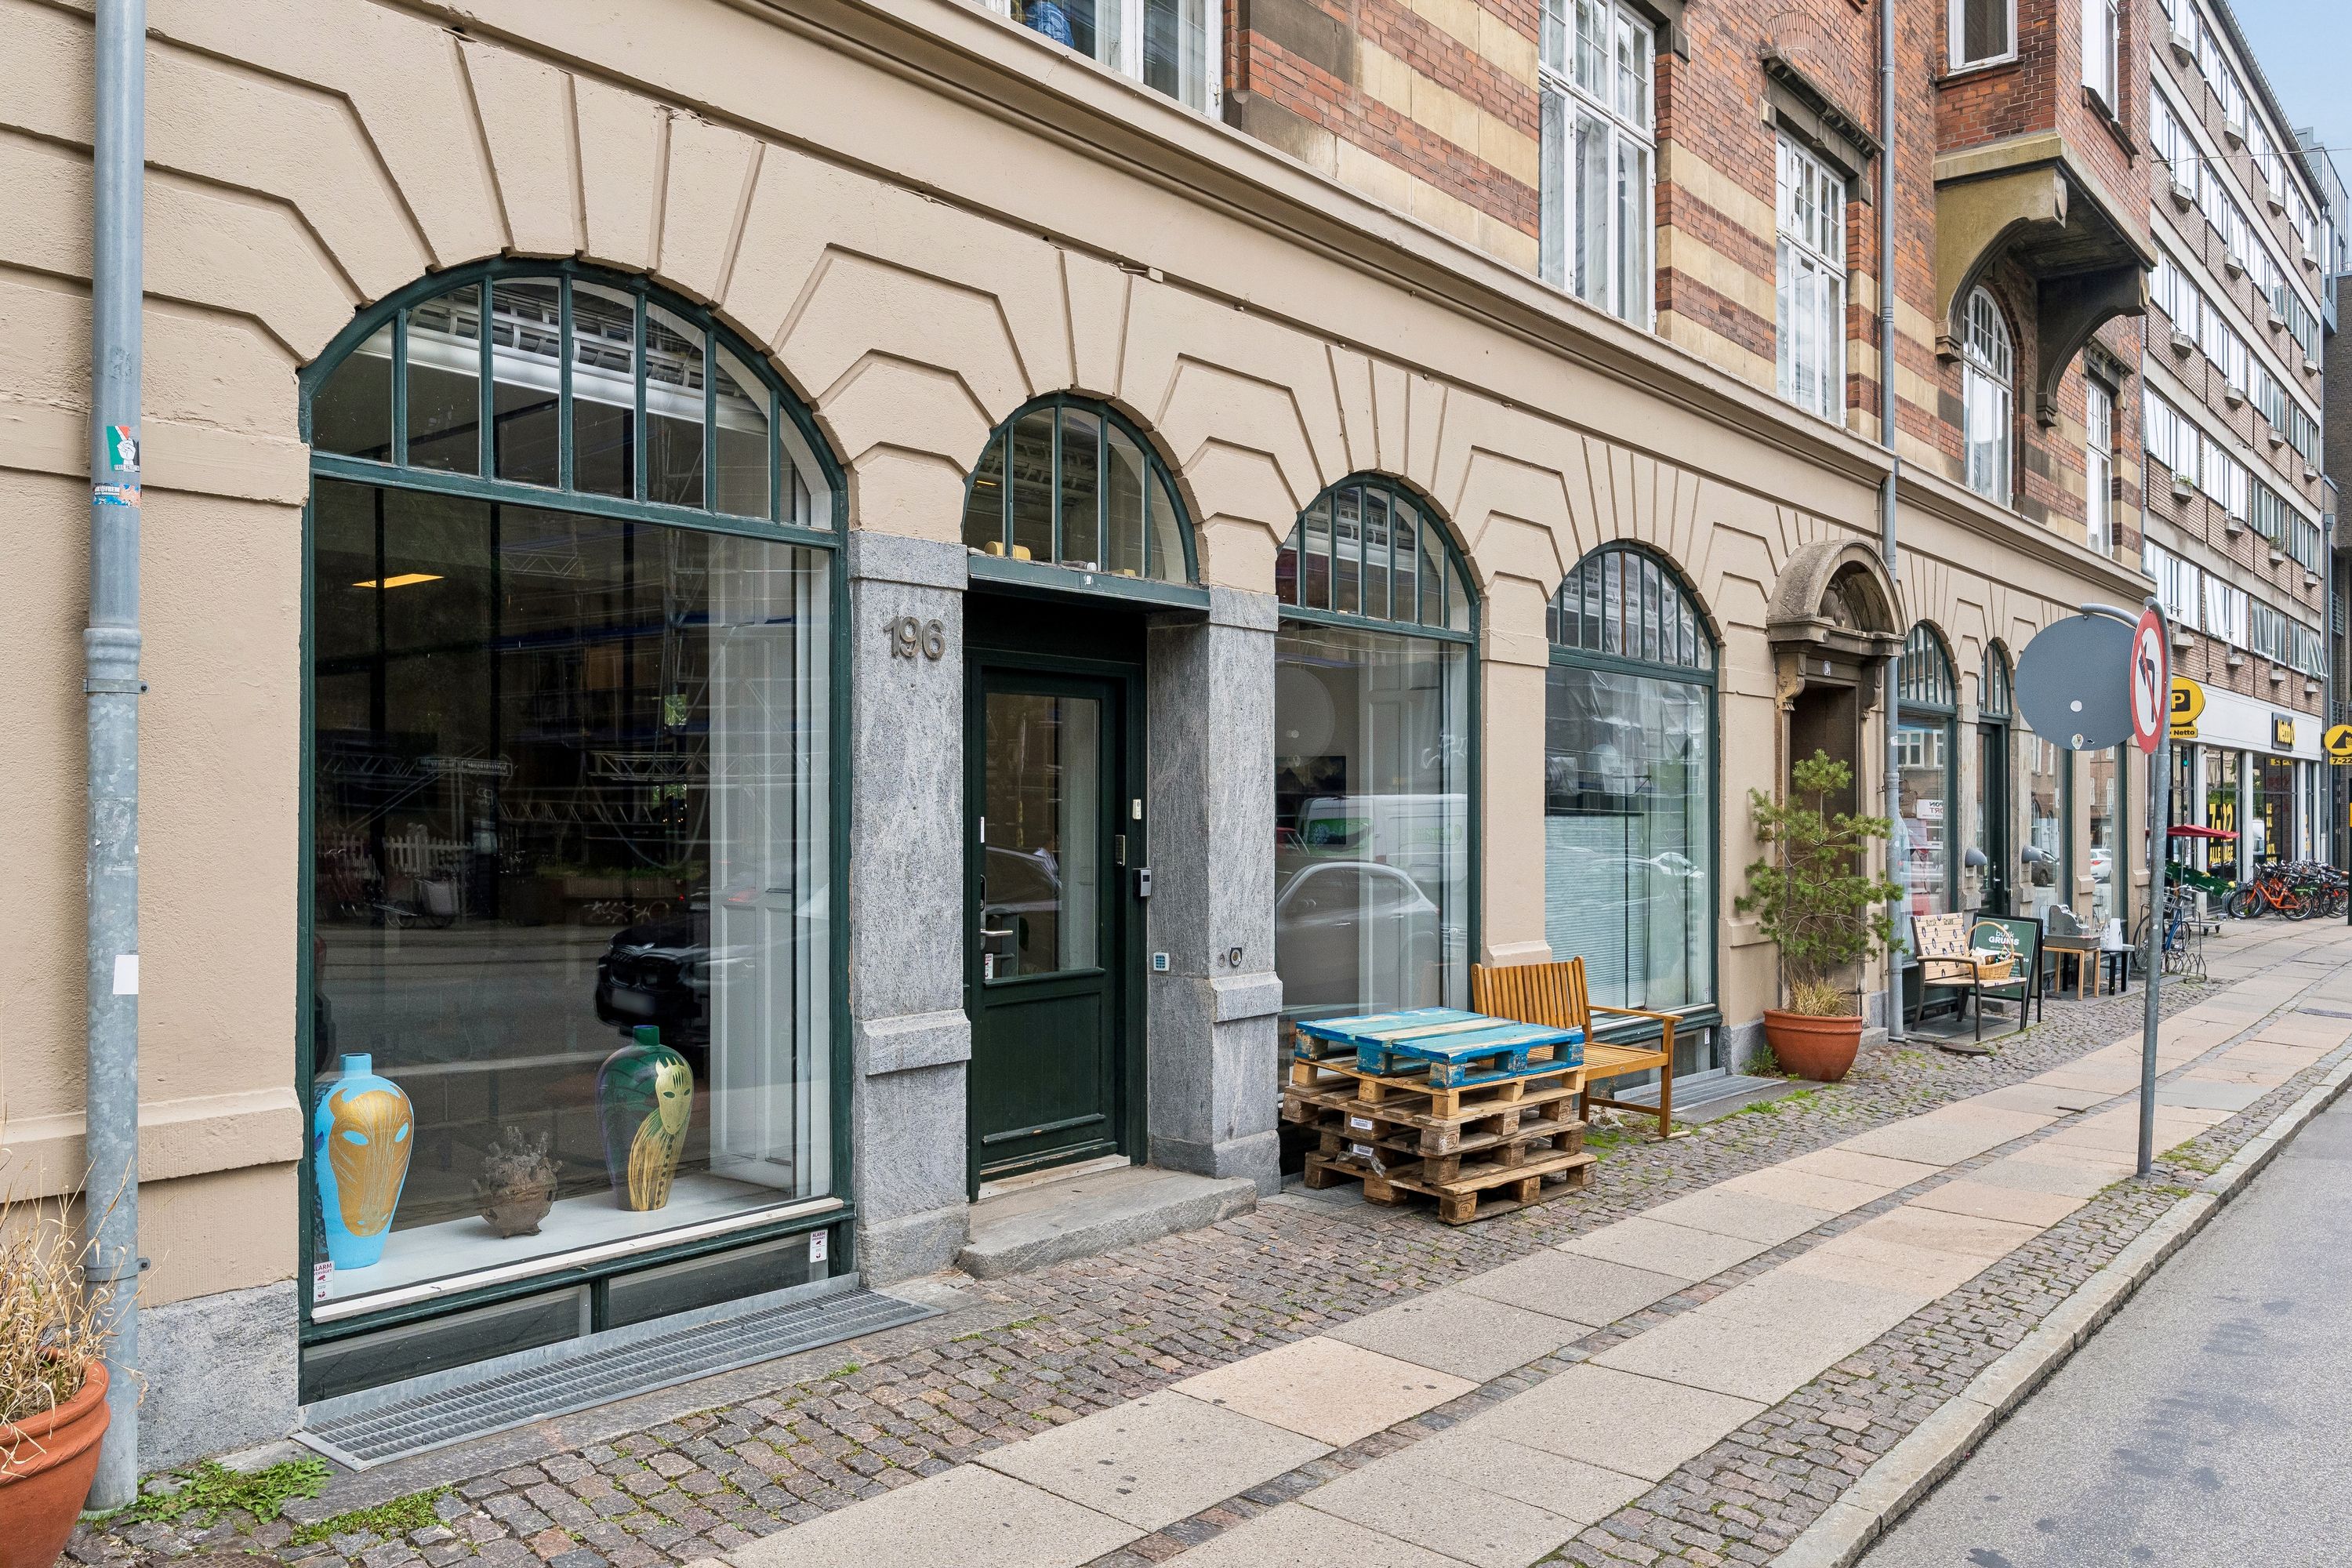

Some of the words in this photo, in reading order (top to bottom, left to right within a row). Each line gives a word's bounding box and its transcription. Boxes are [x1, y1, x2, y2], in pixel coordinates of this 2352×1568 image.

[883, 615, 946, 660] 196
[2172, 693, 2185, 709] P
[2278, 718, 2291, 744] Netto
[2209, 846, 2221, 865] ALLE
[314, 1263, 332, 1272] LARM
